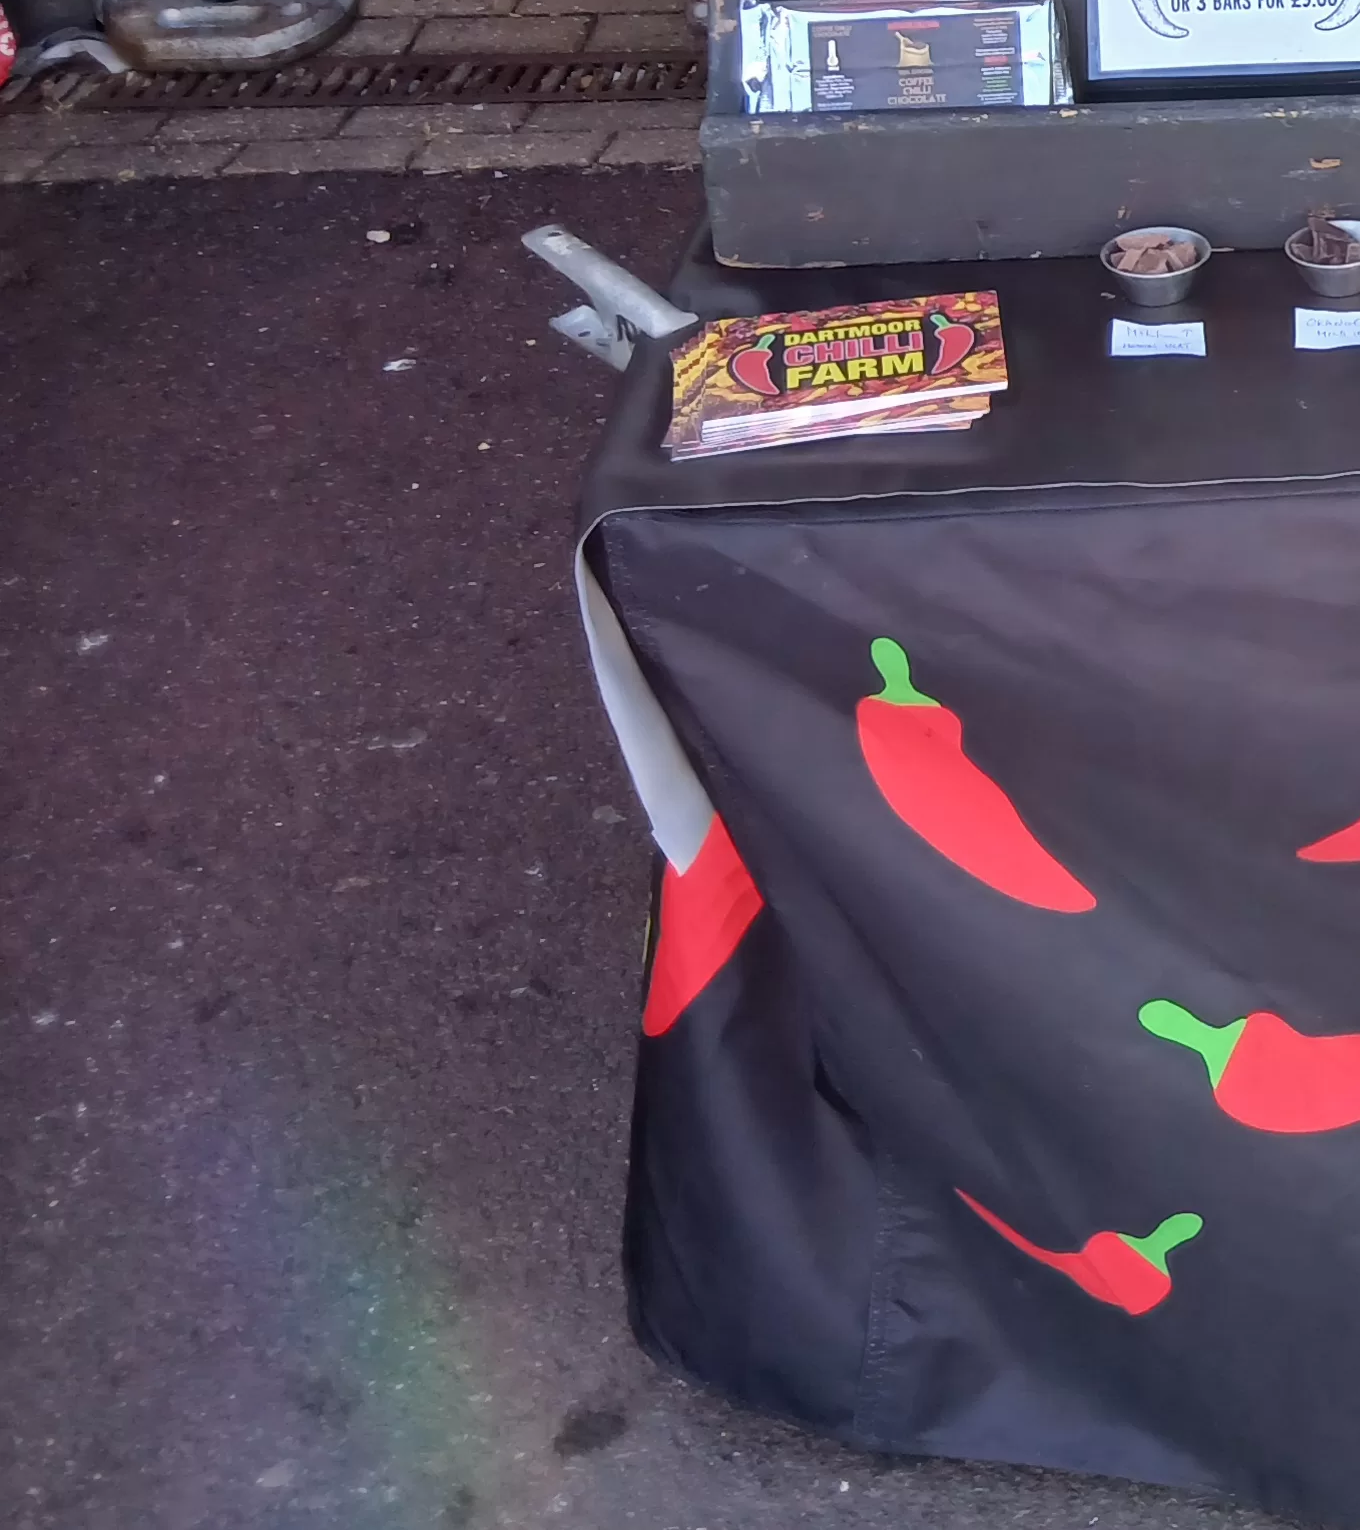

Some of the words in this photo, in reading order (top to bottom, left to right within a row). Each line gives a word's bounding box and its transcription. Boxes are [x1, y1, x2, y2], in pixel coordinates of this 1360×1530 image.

[898, 77, 934, 86] COFFEE
[903, 86, 931, 94] CHILLI
[888, 94, 946, 105] CHOCOLATE
[784, 320, 921, 345] DARTMOOR
[784, 332, 923, 365] CHILLI
[786, 352, 923, 389] FARM
